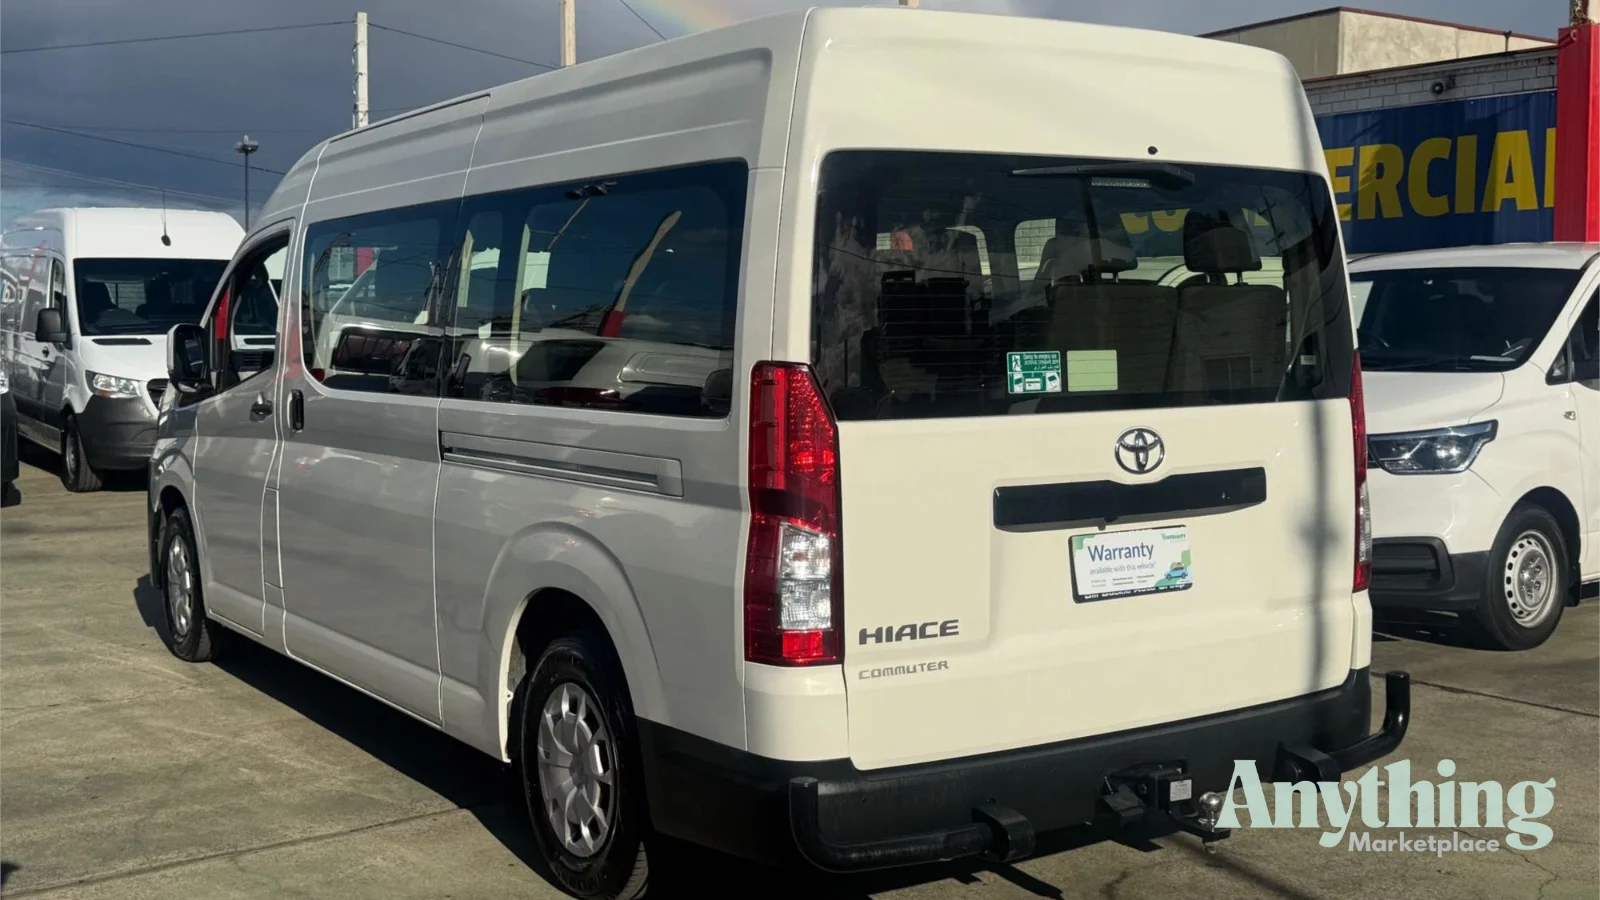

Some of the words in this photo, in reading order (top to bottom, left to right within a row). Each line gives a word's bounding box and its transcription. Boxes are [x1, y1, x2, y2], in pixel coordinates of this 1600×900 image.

[1087, 542, 1154, 562] Warranty
[1090, 565, 1113, 575] available
[1113, 564, 1126, 573] with
[1126, 563, 1137, 571] this
[858, 619, 960, 645] HIACE
[858, 660, 949, 680] COMMUTER
